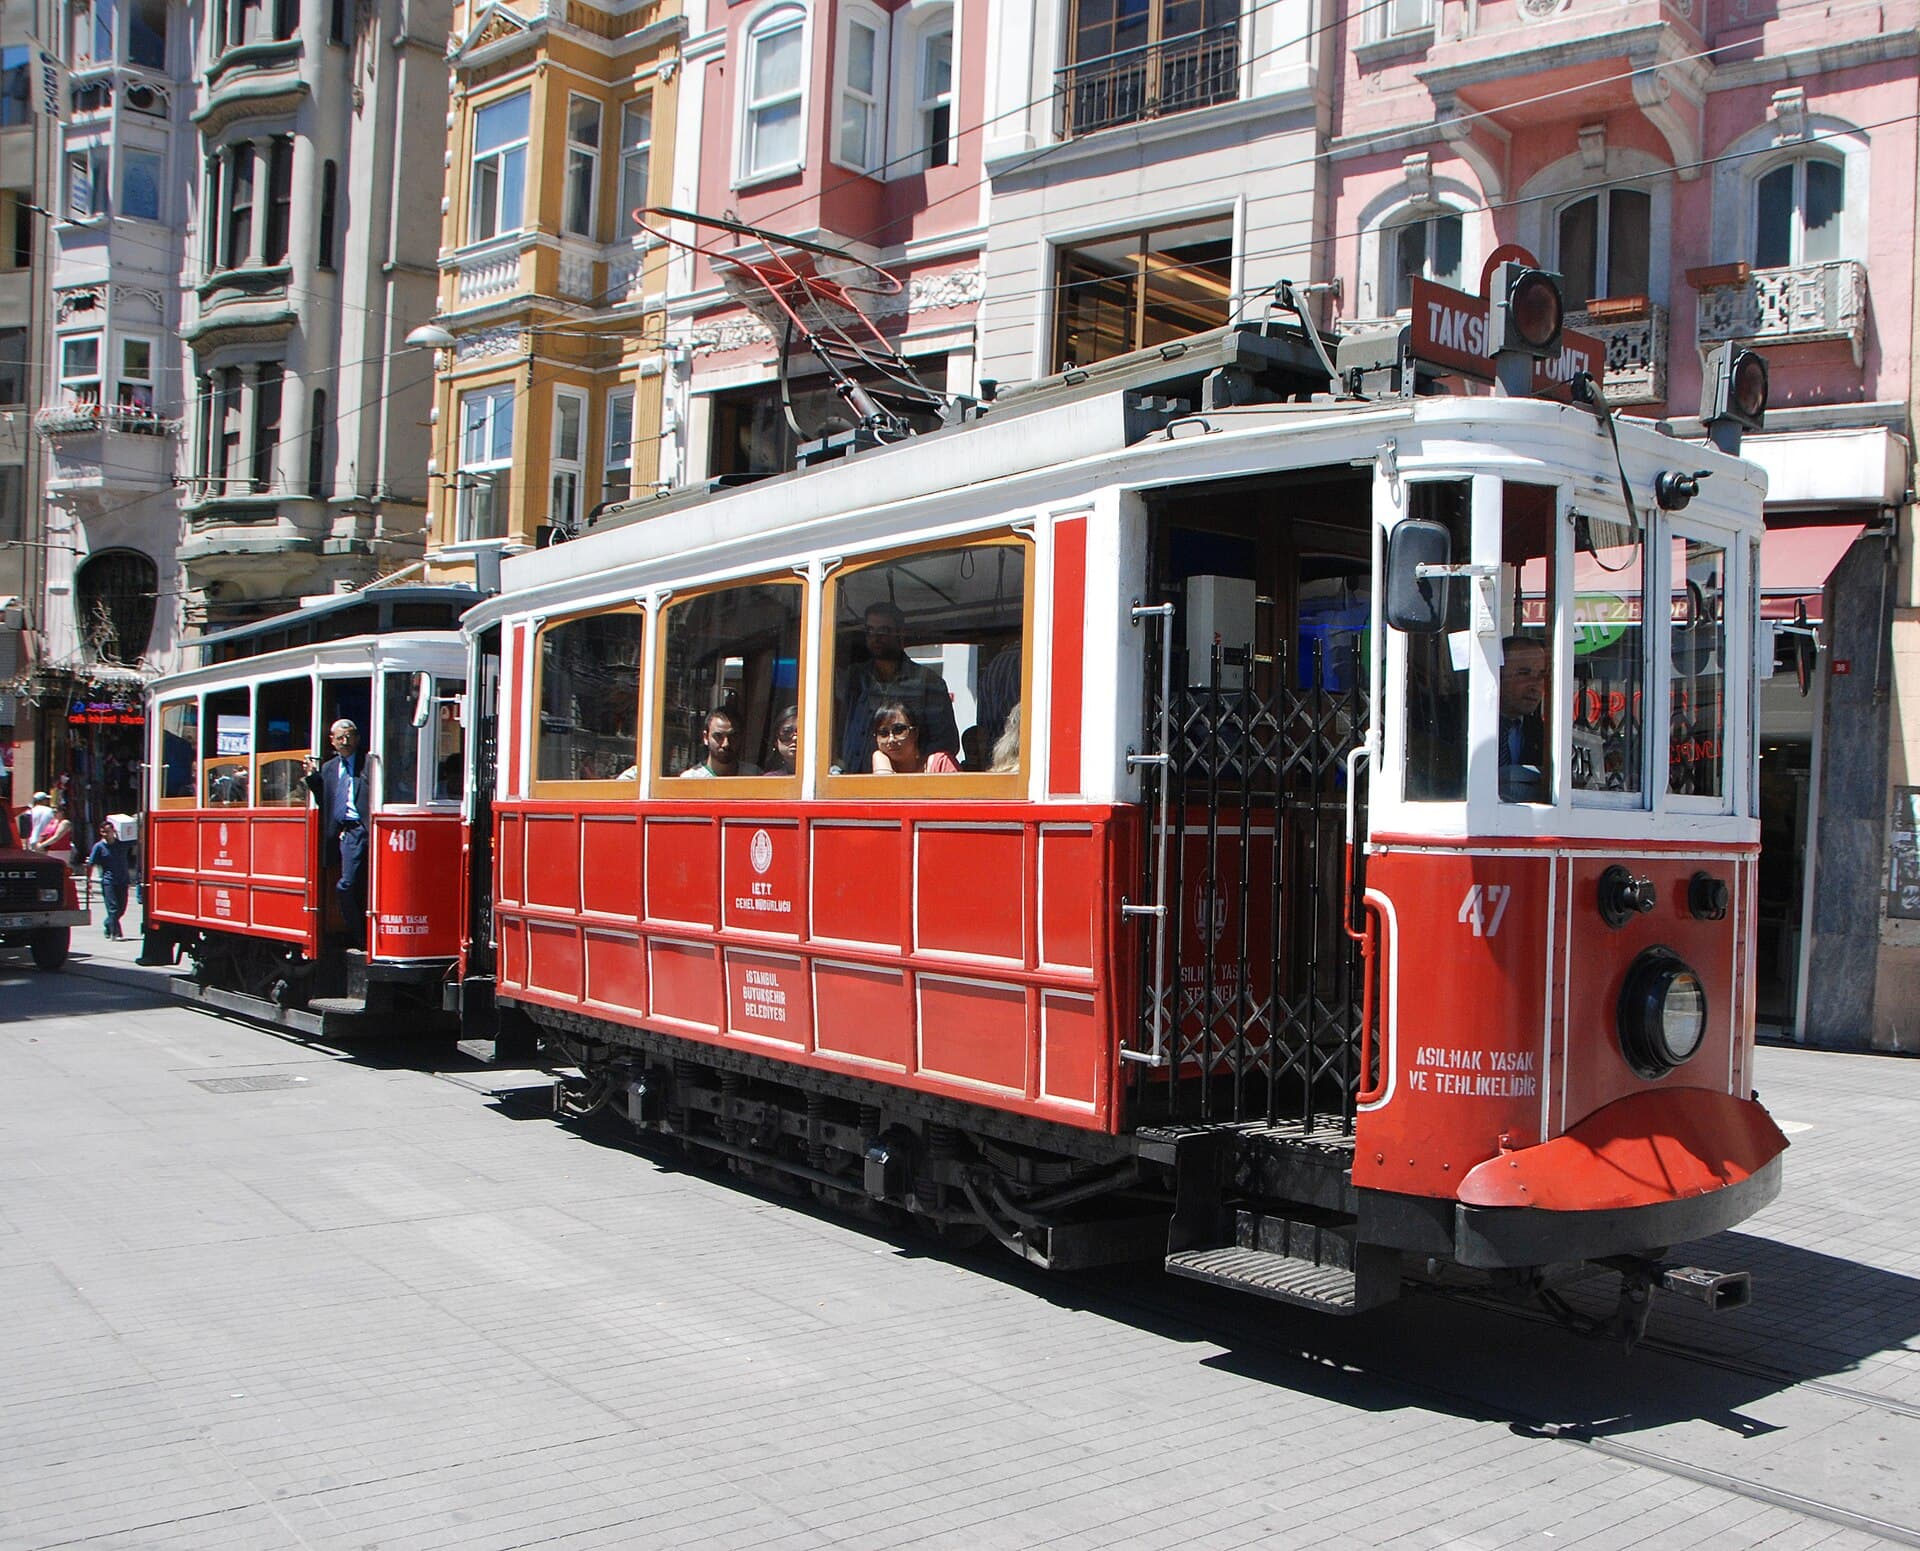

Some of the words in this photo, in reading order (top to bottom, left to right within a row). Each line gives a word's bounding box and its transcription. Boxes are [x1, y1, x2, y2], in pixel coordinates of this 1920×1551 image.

[1427, 301, 1490, 360] TAKSİ
[388, 829, 417, 852] 418
[1457, 884, 1511, 937] 47
[1416, 1046, 1482, 1070] ASILMAK
[1489, 1051, 1535, 1071] YASAK
[1409, 1070, 1428, 1091] VE
